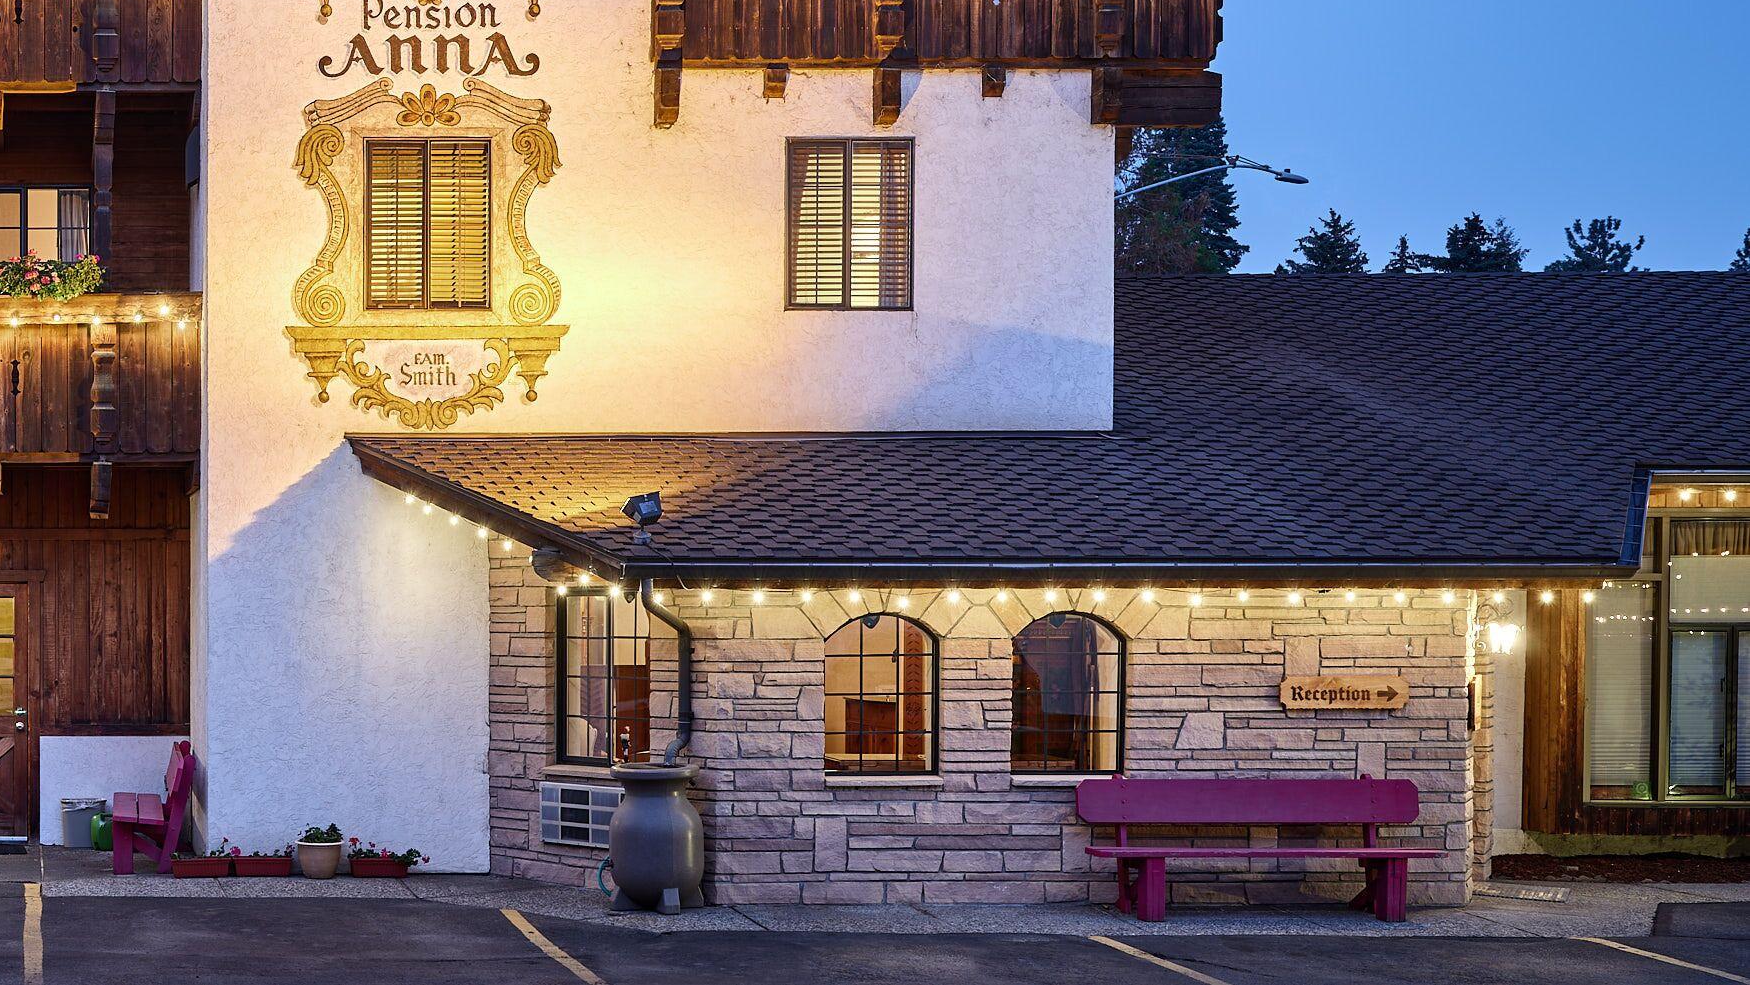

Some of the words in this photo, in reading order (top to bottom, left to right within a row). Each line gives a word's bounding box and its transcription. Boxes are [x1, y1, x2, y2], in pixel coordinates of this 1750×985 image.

[318, 32, 540, 77] ANNA
[400, 363, 457, 386] Smith
[1290, 685, 1371, 705] Reception
